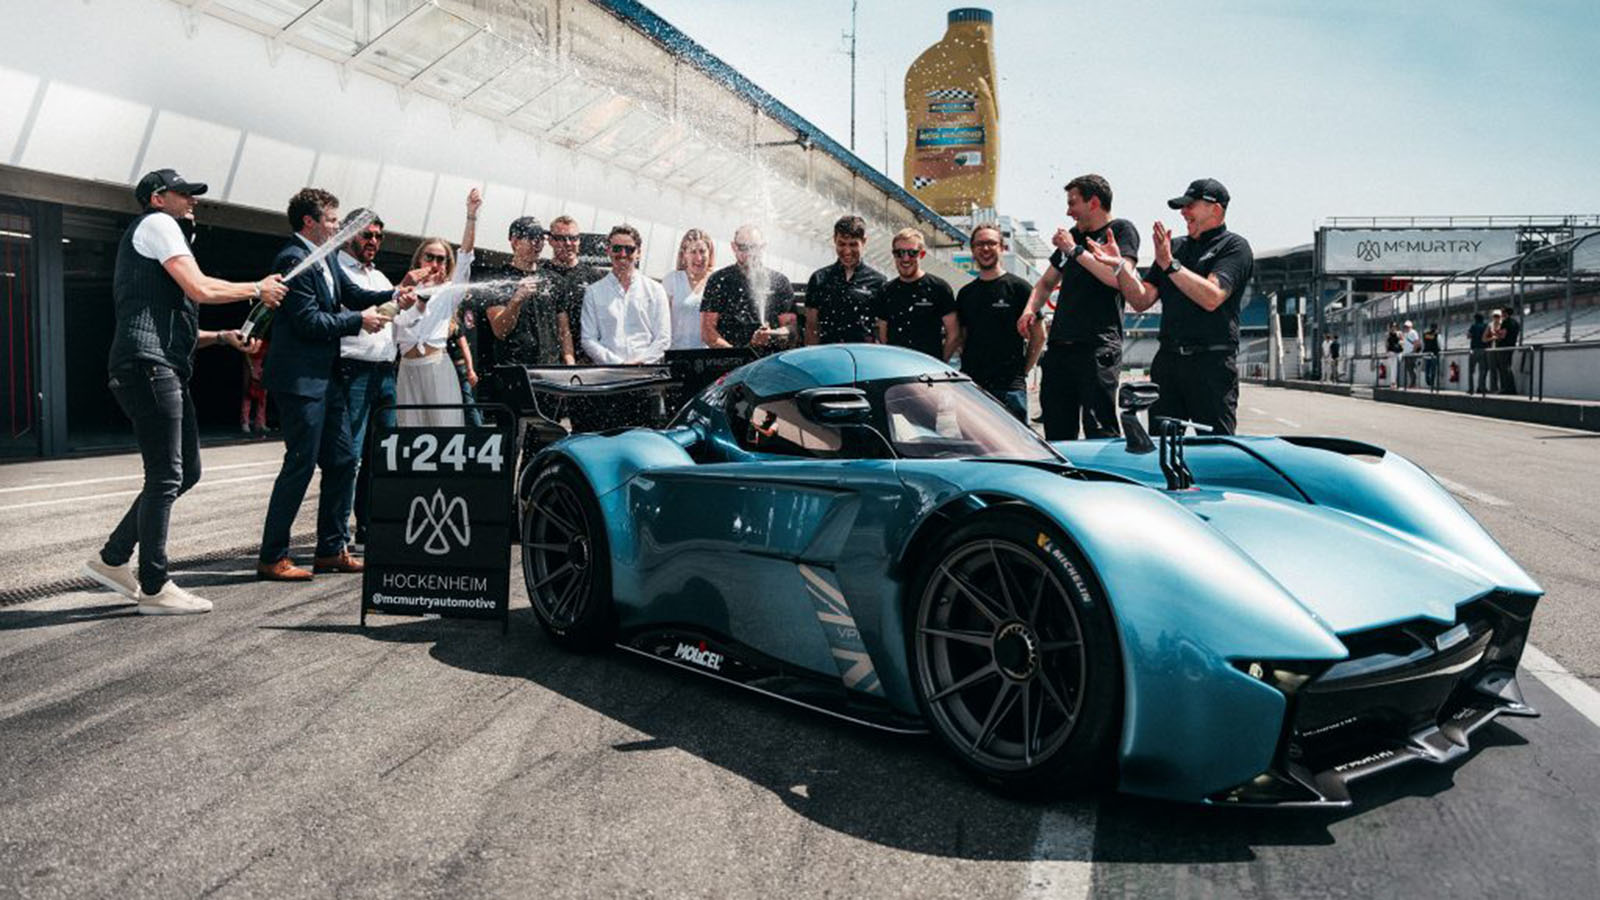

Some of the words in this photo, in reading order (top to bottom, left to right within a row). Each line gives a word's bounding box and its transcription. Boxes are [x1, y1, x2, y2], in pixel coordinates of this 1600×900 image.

[382, 573, 487, 591] HOCKENHEIM
[1052, 549, 1092, 602] MICHELIN
[372, 592, 496, 609] @mcmurtryautomotive
